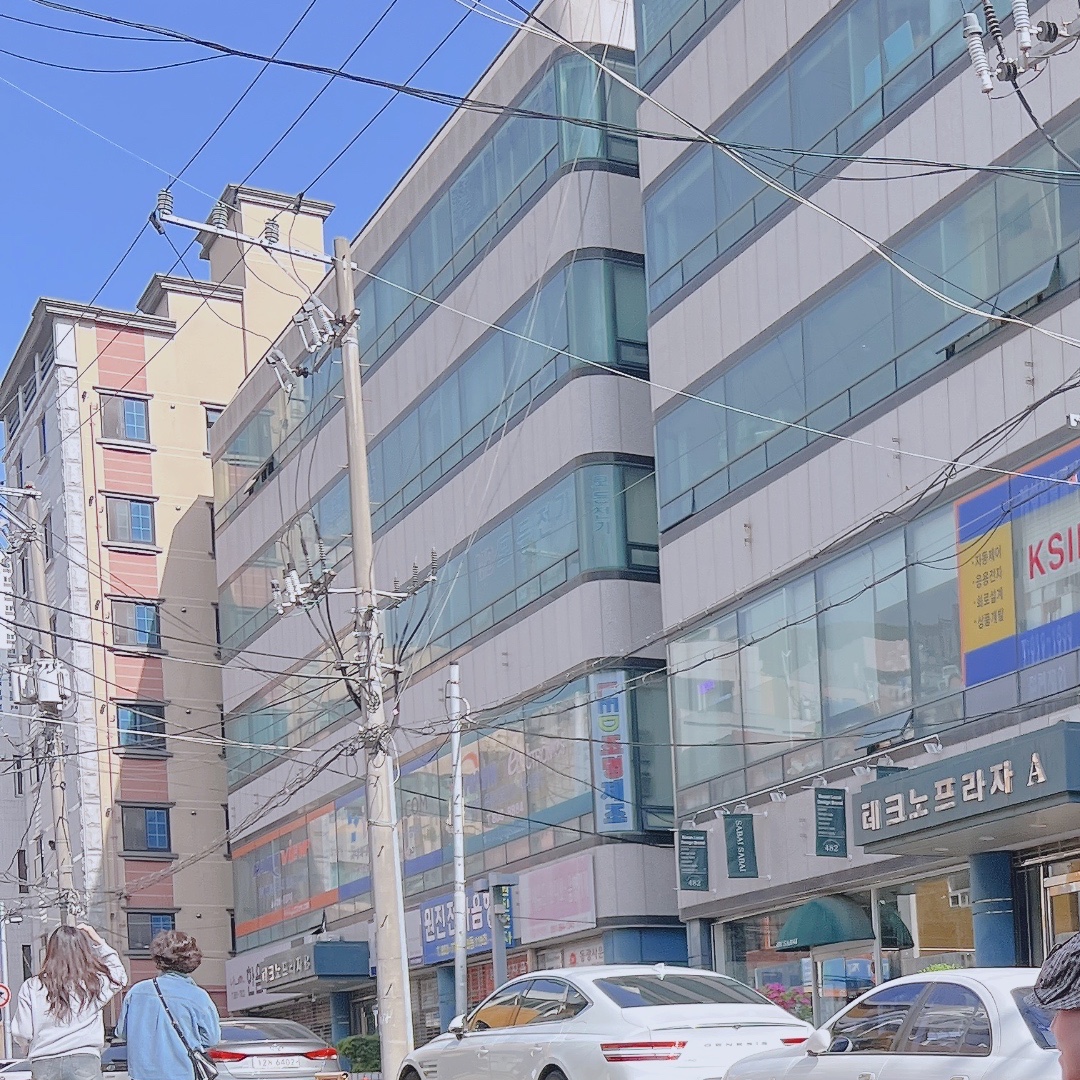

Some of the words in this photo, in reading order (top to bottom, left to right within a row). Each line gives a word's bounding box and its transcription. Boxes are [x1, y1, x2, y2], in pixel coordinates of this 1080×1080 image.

[861, 759, 1014, 831] 테크노프라자
[1026, 751, 1048, 788] A
[735, 820, 745, 846] SABAI
